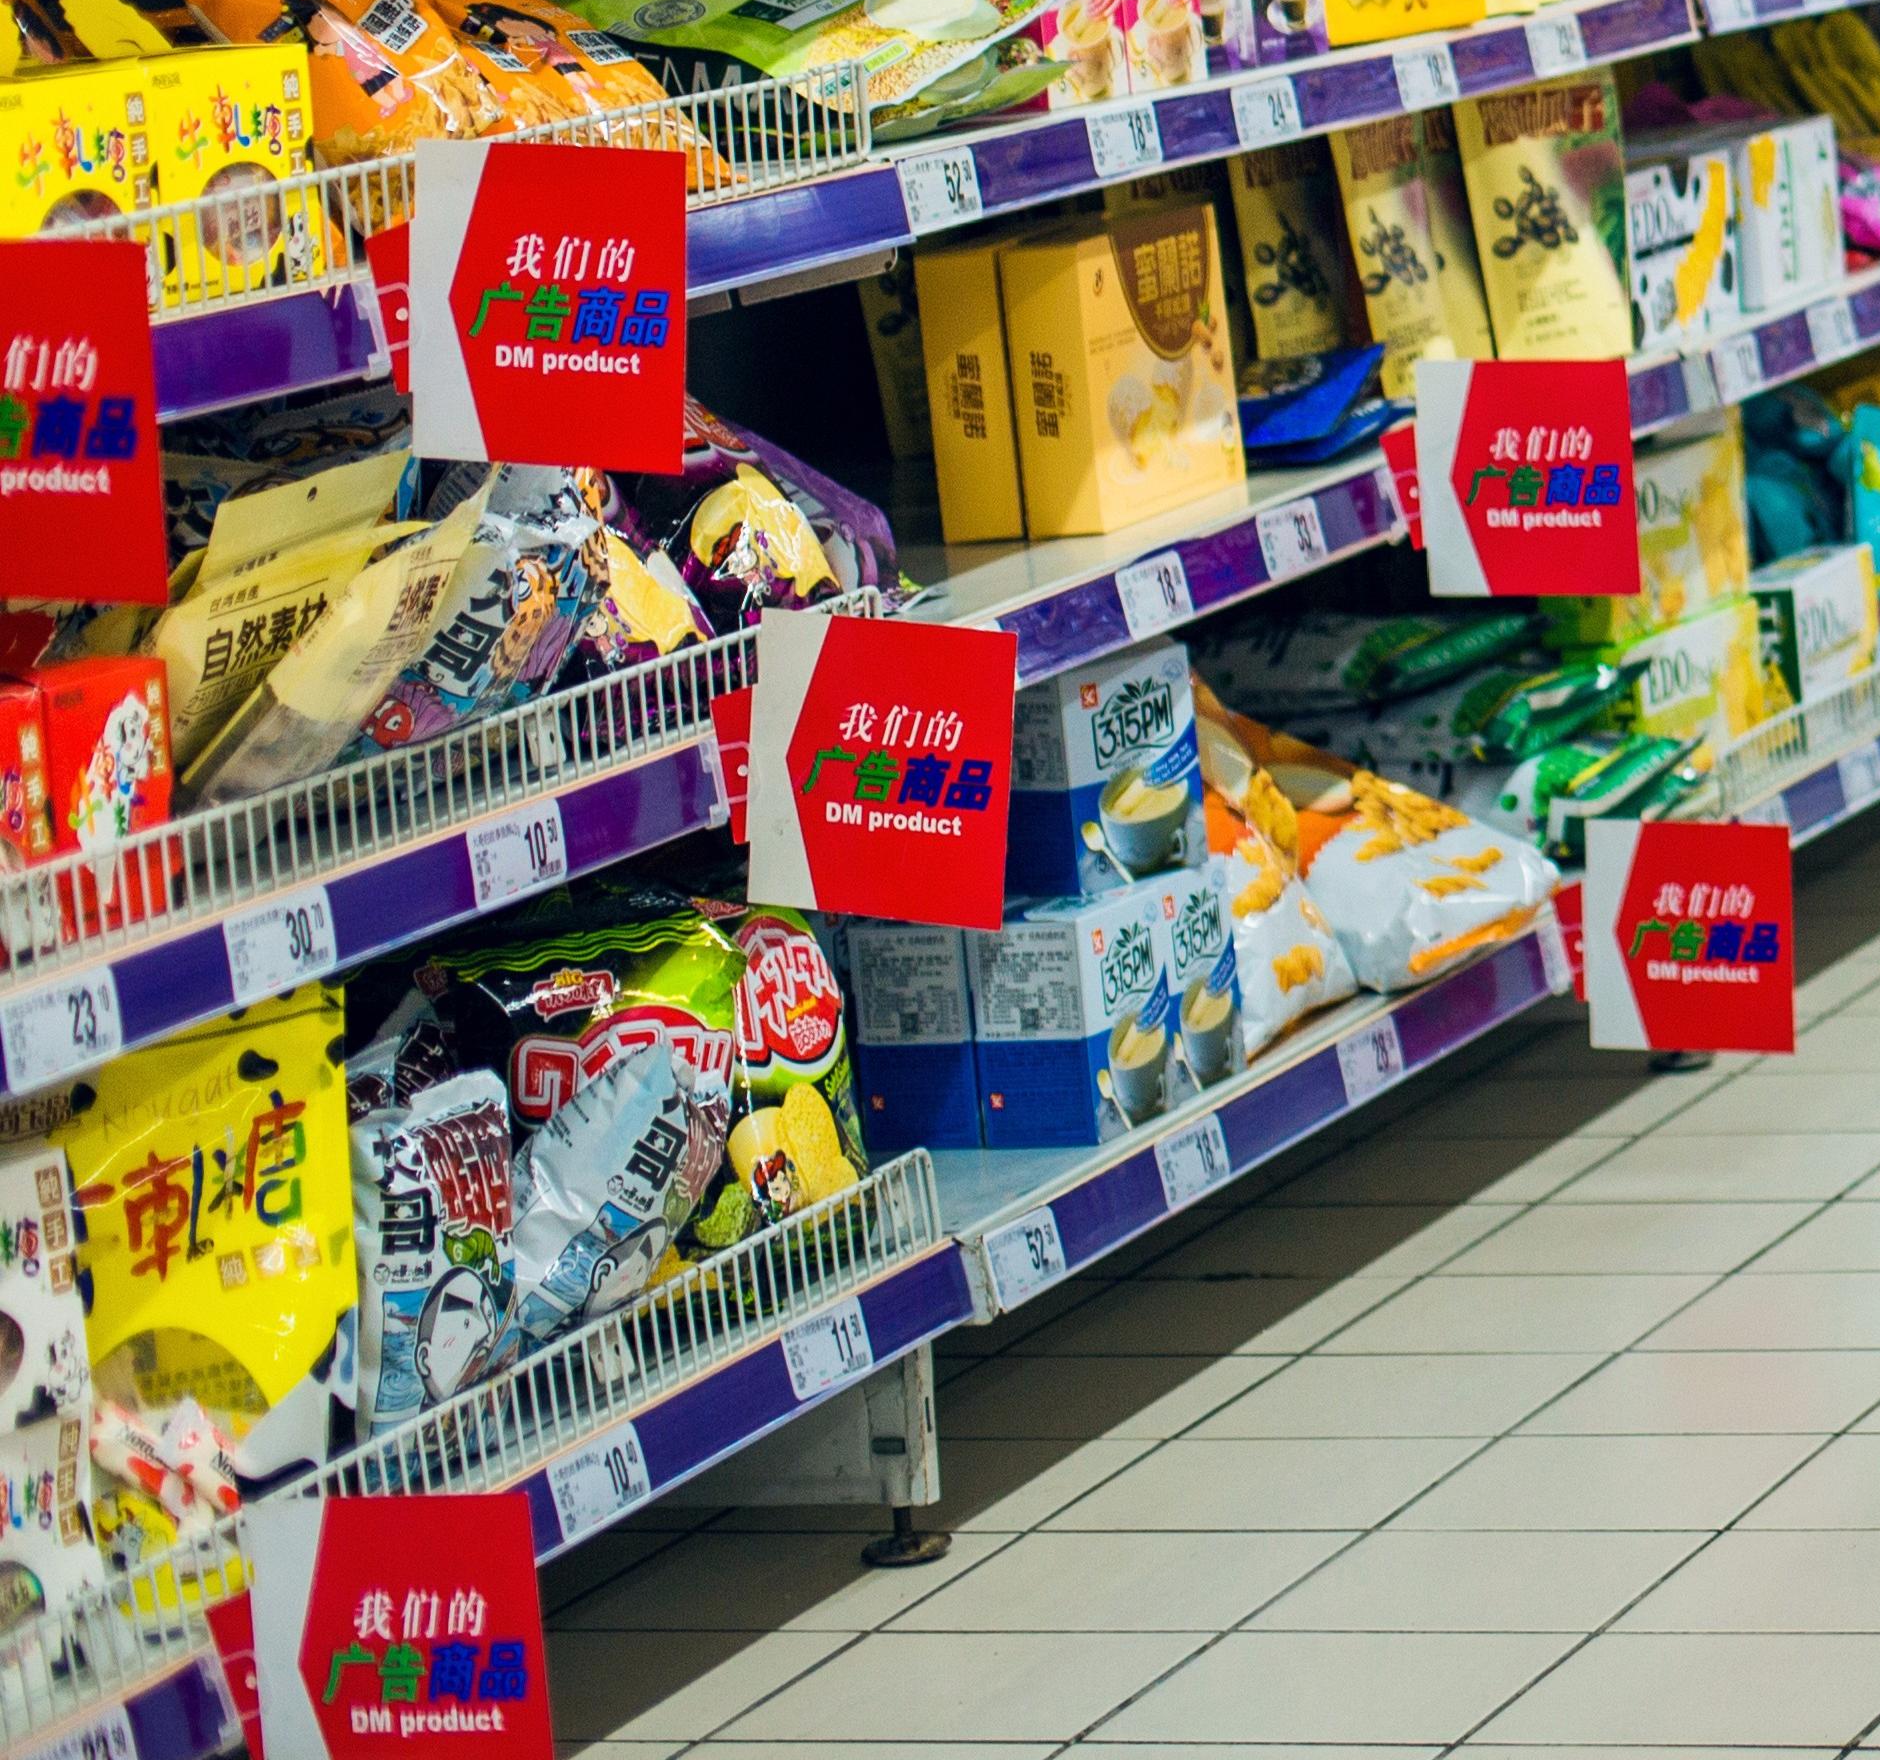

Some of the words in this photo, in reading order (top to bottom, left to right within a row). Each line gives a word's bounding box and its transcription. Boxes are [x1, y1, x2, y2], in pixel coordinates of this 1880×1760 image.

[1267, 95, 1287, 129] 24
[1127, 118, 1147, 151] 18
[944, 161, 964, 204] 52
[1630, 210, 1669, 250] EDO
[505, 235, 636, 283] 我们的
[469, 282, 671, 347] 广告商品
[495, 345, 535, 369] DM
[542, 348, 641, 376] product
[1490, 425, 1593, 463] 我们的
[1, 465, 111, 497] product
[1467, 464, 1622, 507] 广告商品
[1486, 509, 1519, 528] DM
[1524, 509, 1602, 531] product
[1156, 570, 1177, 606] 18
[201, 591, 328, 683] 自然素材
[1646, 651, 1691, 705] EDO
[839, 701, 964, 751] 我们的
[1097, 690, 1172, 760] 3:15PM
[801, 746, 993, 812] 广告商品
[825, 802, 862, 824] DM
[868, 810, 962, 839] product
[523, 820, 547, 872] 10
[1654, 883, 1754, 920] 我们的
[283, 908, 313, 961] 30
[1626, 918, 1780, 964] 广告商品
[1646, 962, 1677, 983] DM
[1681, 962, 1760, 986] product
[67, 992, 97, 1045] 23
[1193, 1136, 1213, 1174] 18
[1025, 1227, 1049, 1270] 52
[831, 1316, 854, 1363] 11
[604, 1446, 630, 1496] 10
[354, 1589, 486, 1641] 我们的
[322, 1641, 528, 1706] 广告商品
[350, 1707, 391, 1735] DM
[400, 1708, 504, 1739] product
